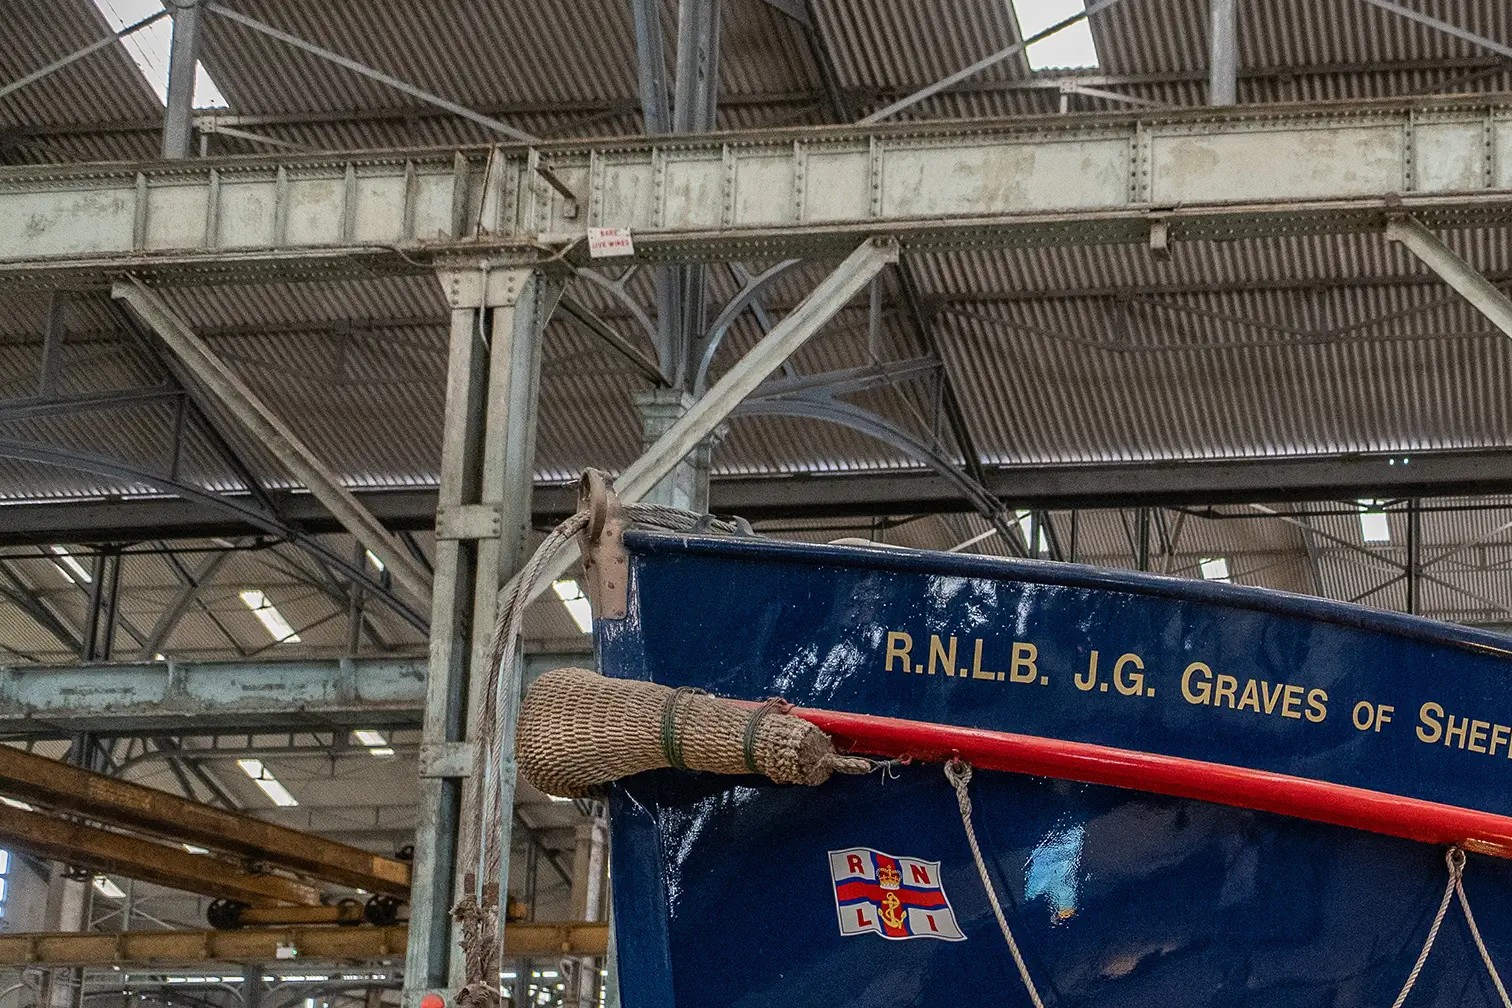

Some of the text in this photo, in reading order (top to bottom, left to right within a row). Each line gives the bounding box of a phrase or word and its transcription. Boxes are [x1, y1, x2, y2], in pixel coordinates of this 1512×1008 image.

[885, 631, 1049, 686] R.N.L.B.
[1074, 650, 1156, 697] J.G.
[1181, 661, 1328, 723] GRAVES
[1352, 700, 1395, 733] OF
[846, 854, 931, 885] R N
[856, 908, 939, 932] L I
